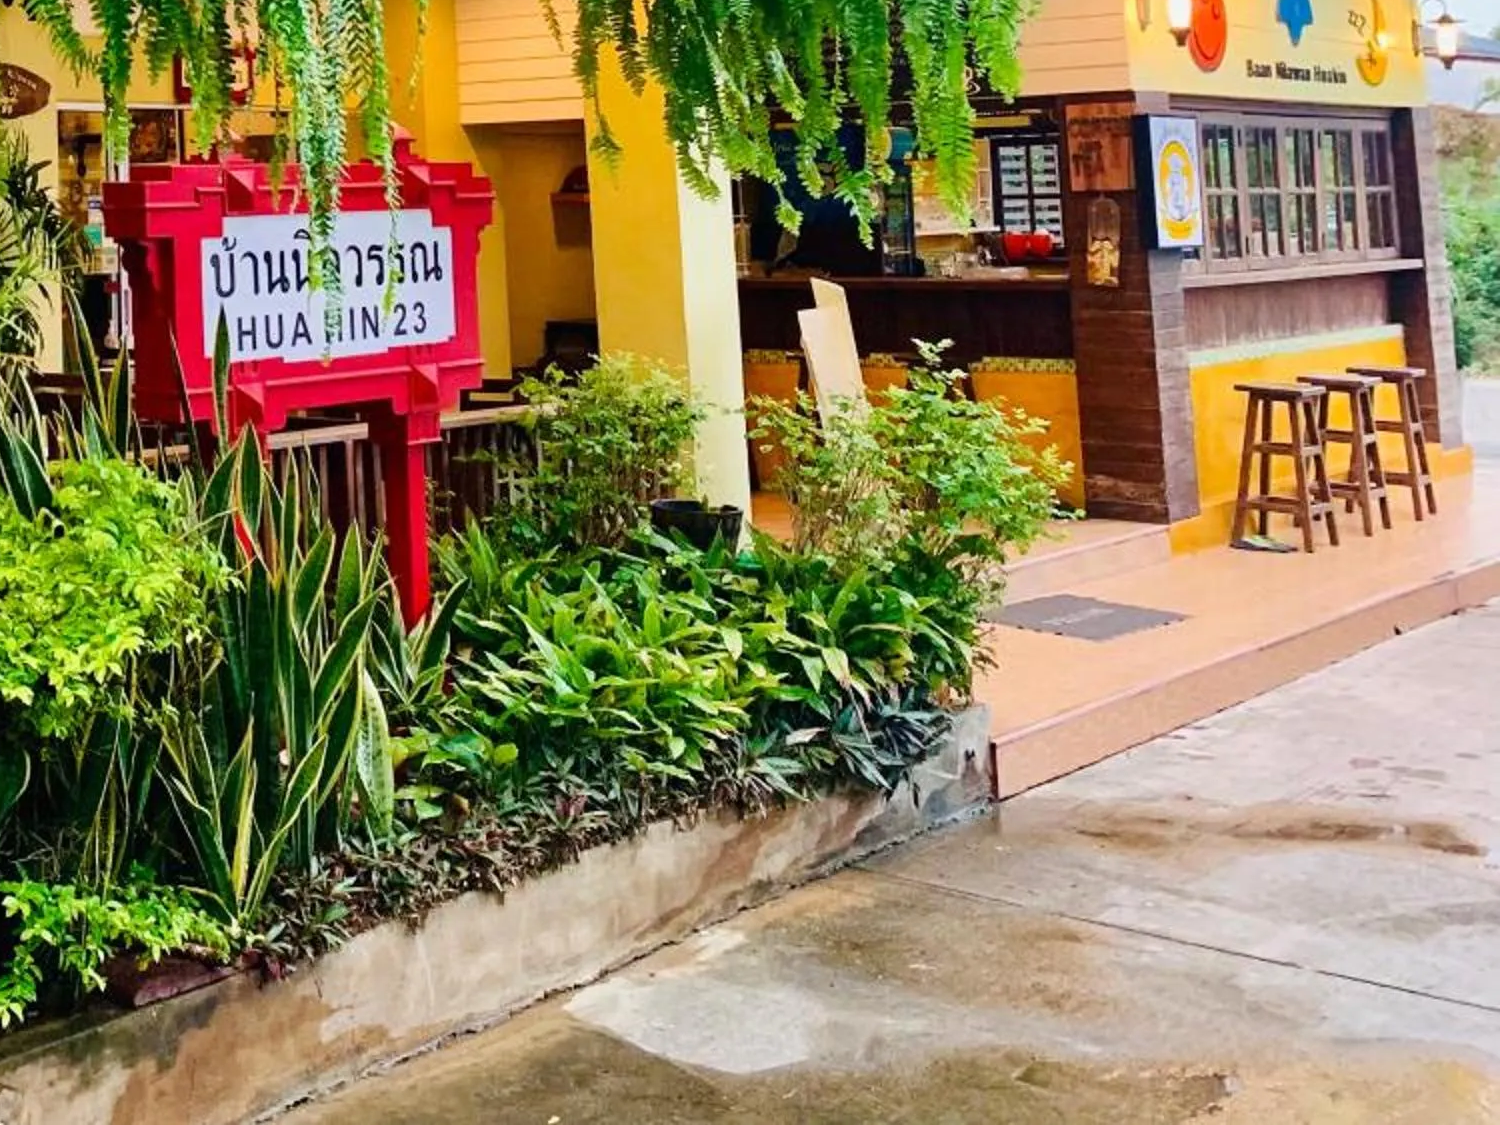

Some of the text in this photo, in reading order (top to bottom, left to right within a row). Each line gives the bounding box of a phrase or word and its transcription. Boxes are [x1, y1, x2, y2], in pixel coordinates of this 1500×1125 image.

[1245, 58, 1272, 79] Baan
[237, 302, 427, 352] HUA HIN 23
